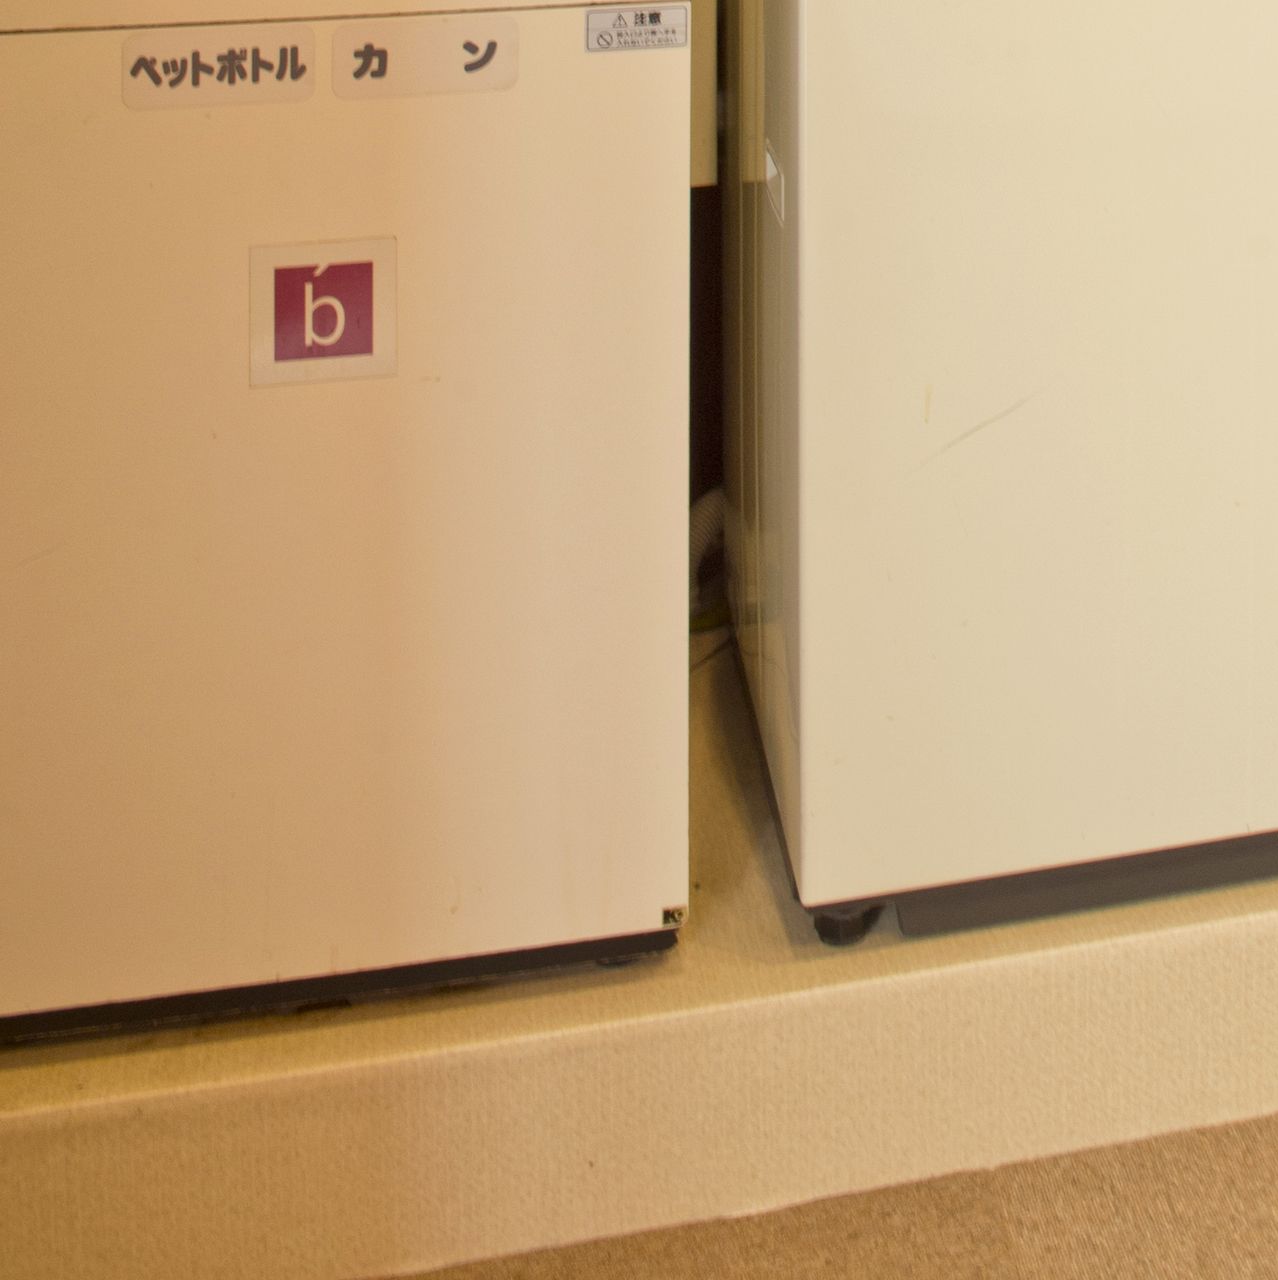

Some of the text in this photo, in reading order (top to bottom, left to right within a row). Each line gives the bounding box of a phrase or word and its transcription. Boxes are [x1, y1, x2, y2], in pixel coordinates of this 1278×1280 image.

[130, 45, 307, 88] ペットボトル
